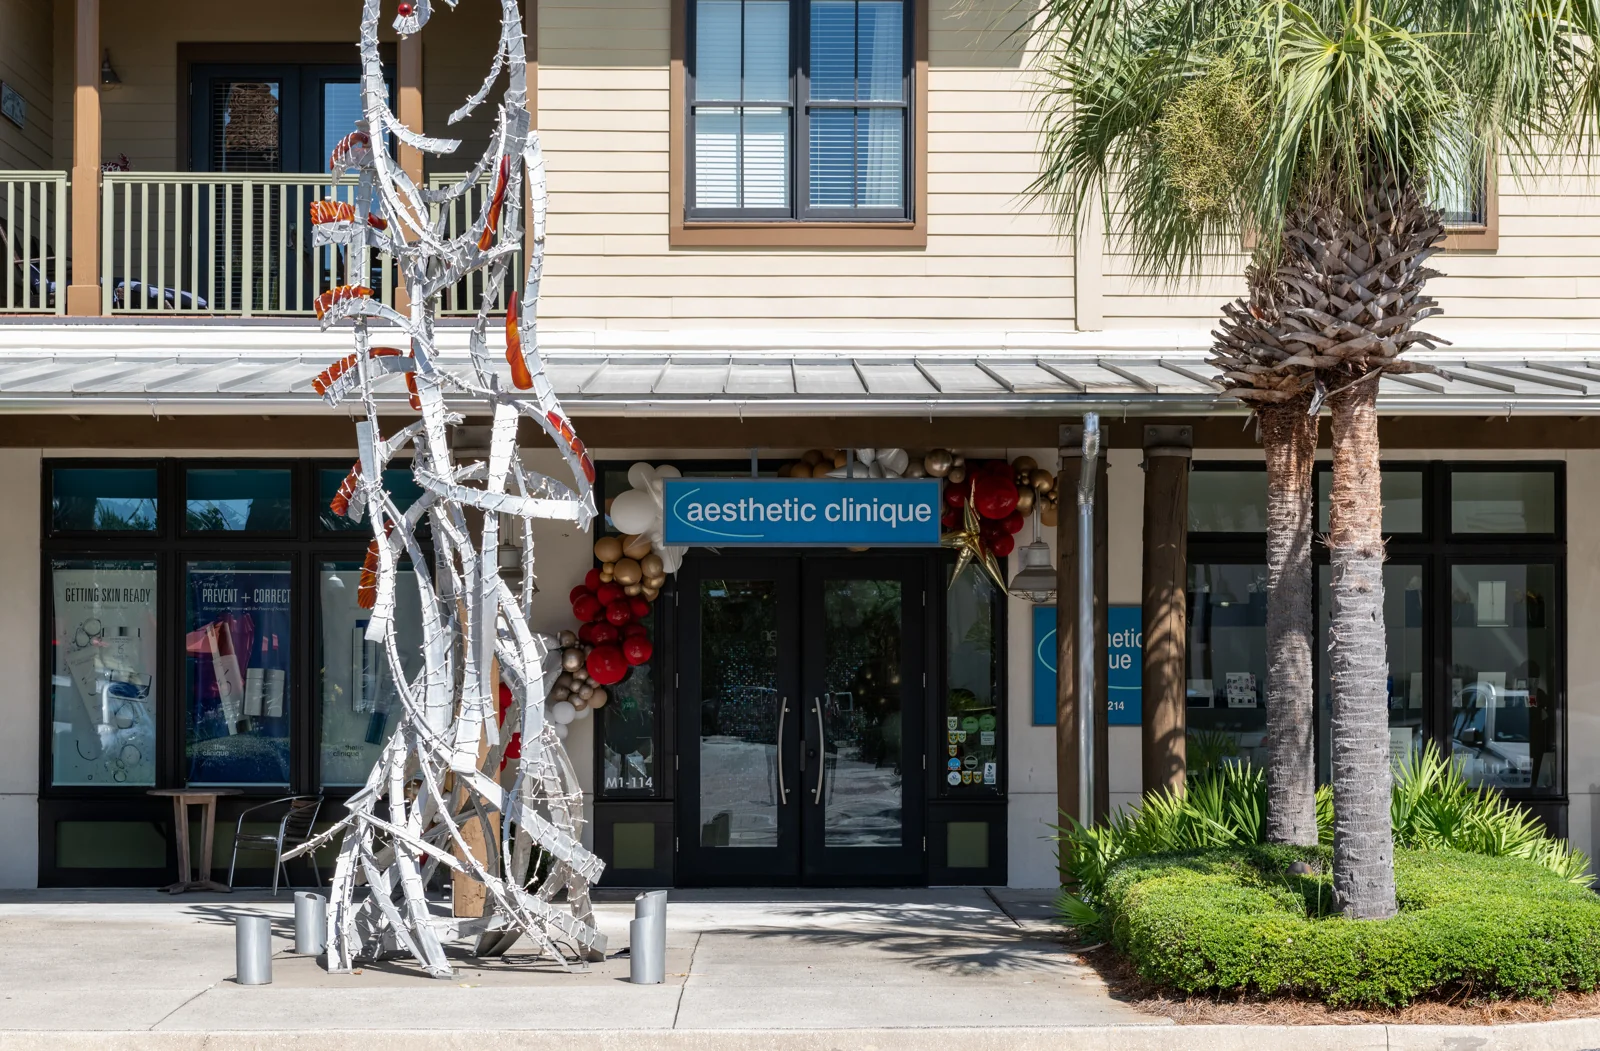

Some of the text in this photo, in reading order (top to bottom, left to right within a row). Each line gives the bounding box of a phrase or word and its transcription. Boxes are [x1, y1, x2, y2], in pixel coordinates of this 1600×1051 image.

[686, 497, 932, 529] aesthetic clinique
[65, 587, 151, 603] GETTING SKIN READY
[202, 588, 238, 603] PREVENT
[253, 588, 292, 603] CORRECT
[605, 776, 653, 788] M1-114
